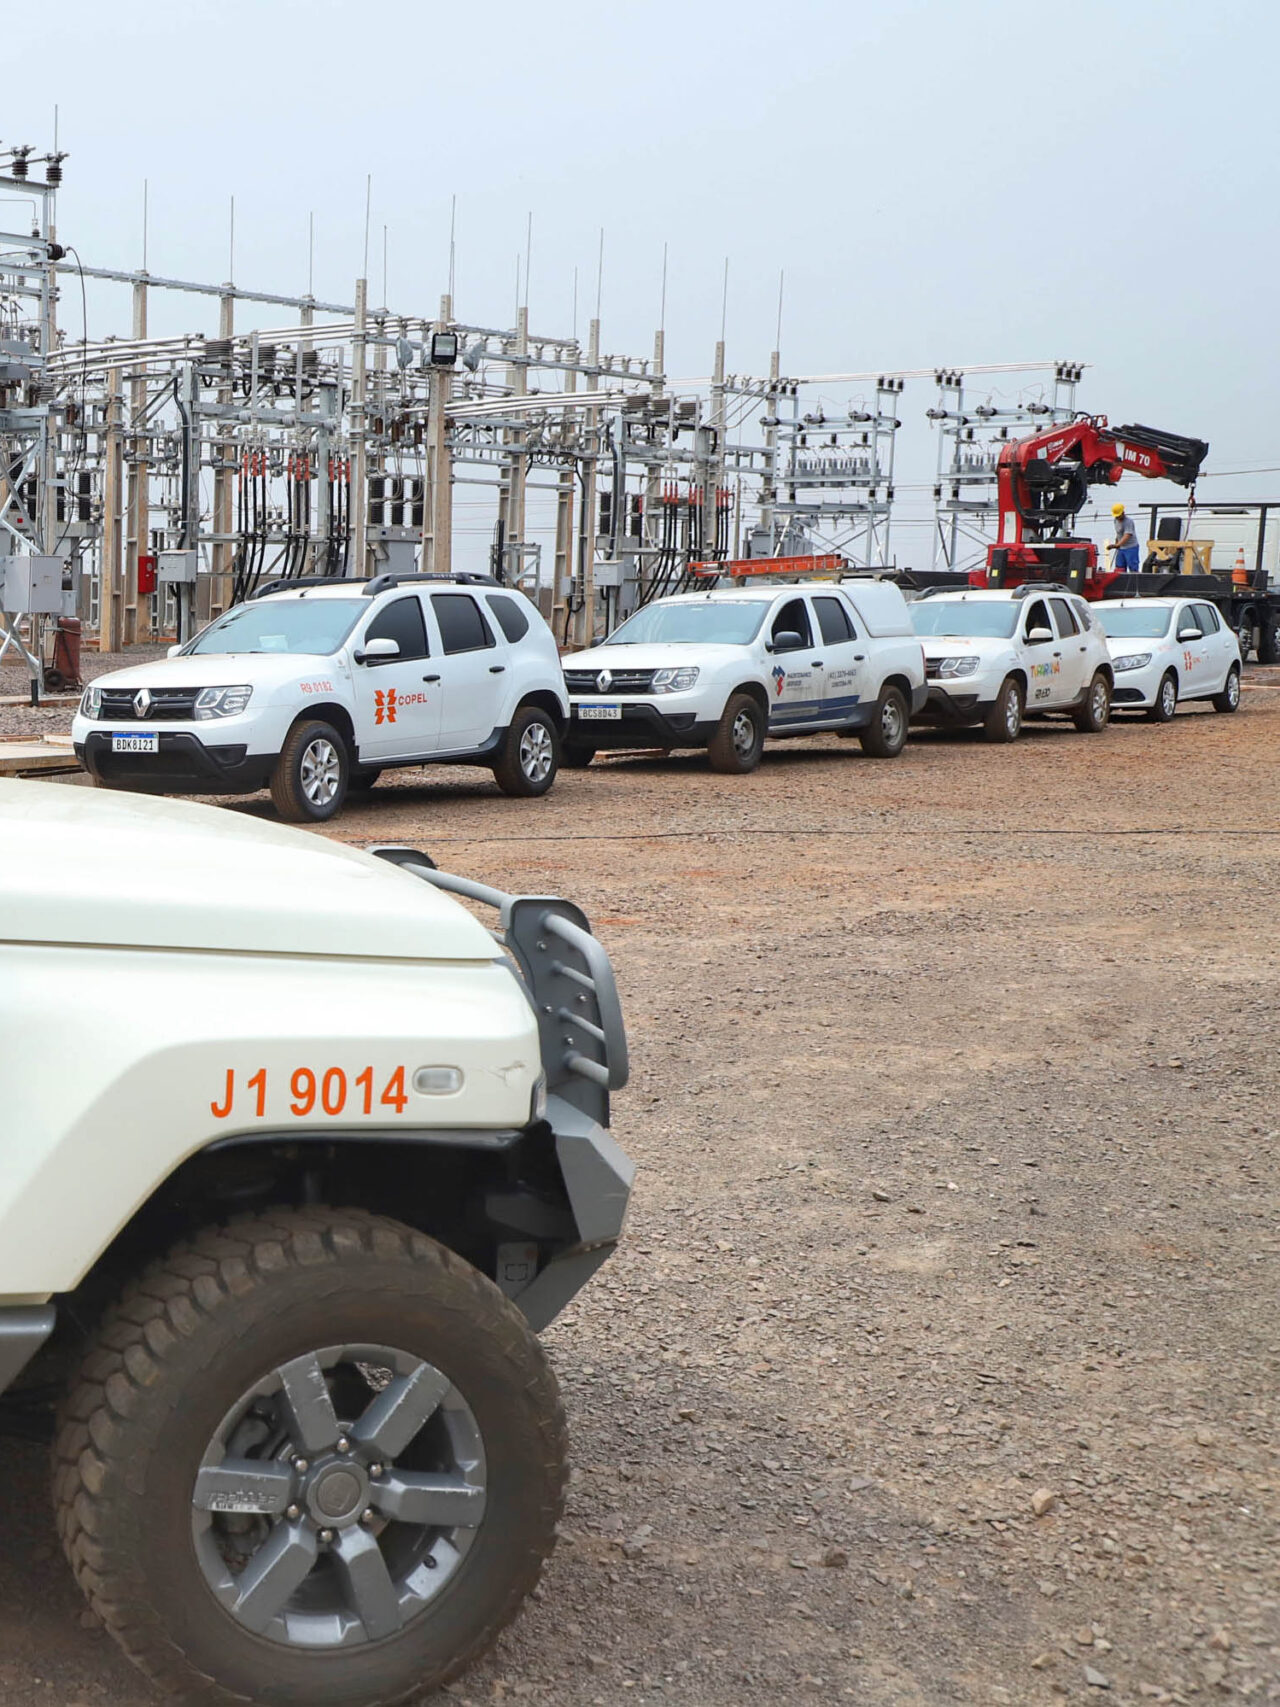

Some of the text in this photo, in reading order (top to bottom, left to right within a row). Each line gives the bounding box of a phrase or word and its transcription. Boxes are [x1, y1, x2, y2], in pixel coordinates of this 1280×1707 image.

[1124, 449, 1151, 467] IM 70
[398, 693, 428, 705] COPEL
[210, 1065, 408, 1118] J1 9014
